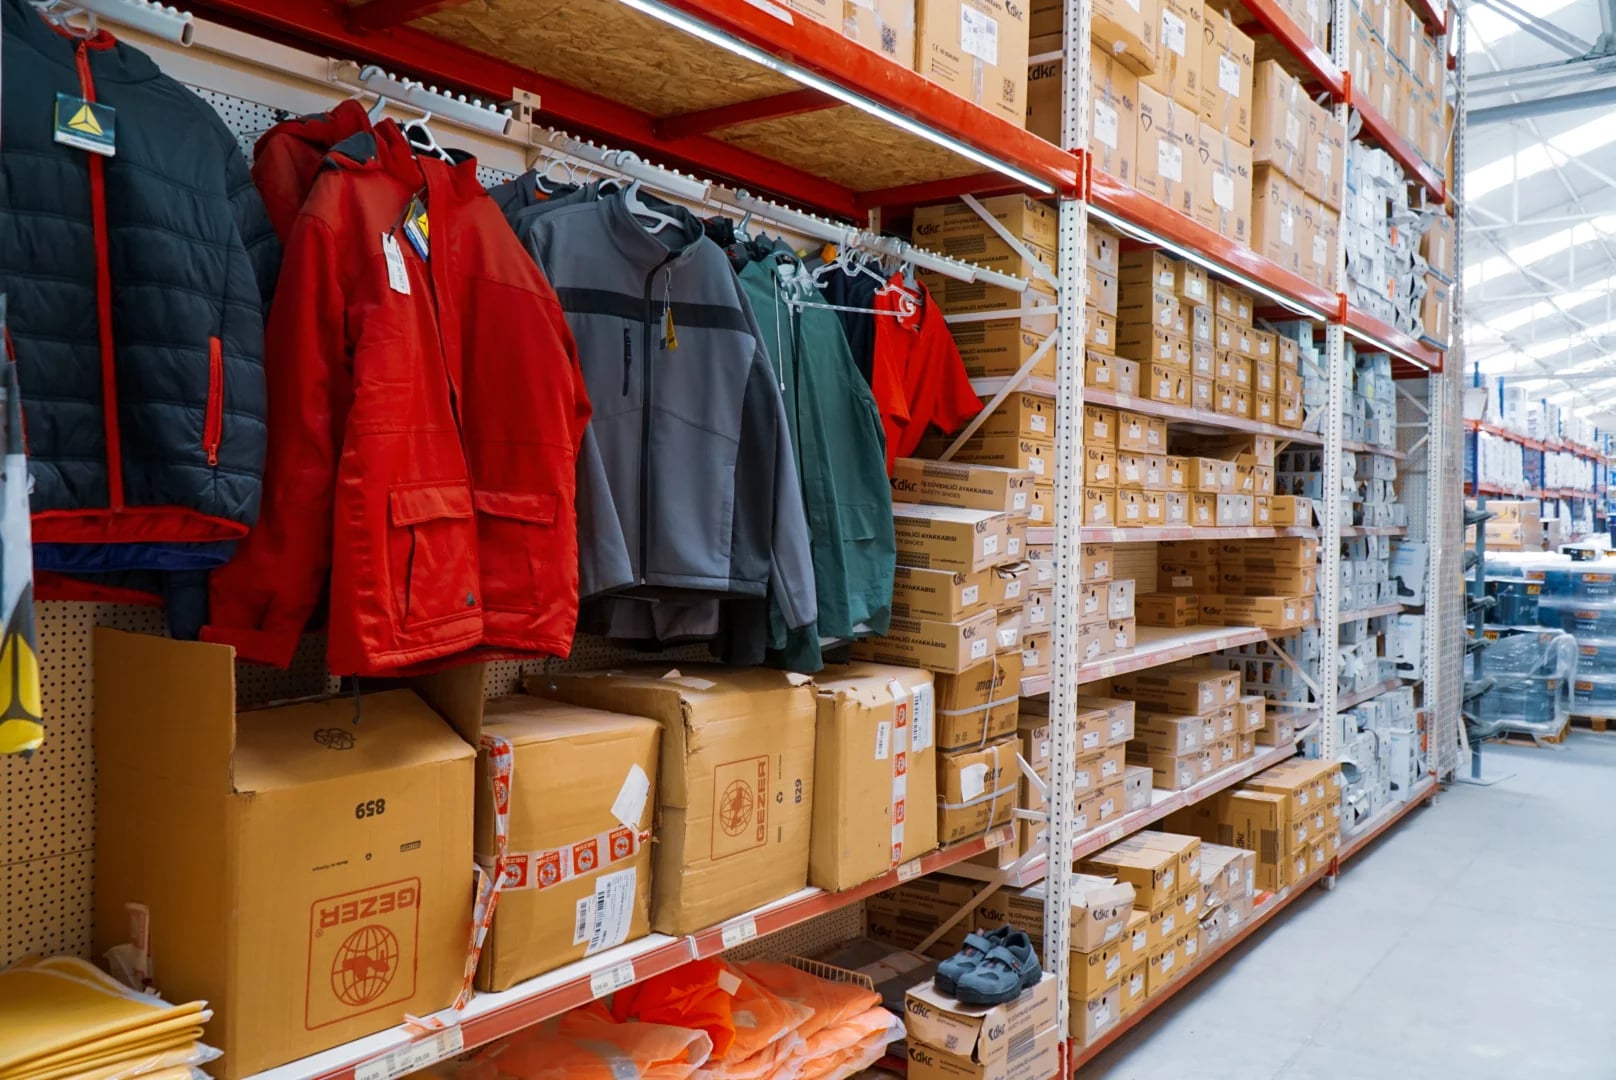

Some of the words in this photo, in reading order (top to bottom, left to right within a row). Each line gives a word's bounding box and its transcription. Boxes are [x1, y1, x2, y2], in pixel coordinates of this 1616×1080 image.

[354, 798, 386, 819] 859
[756, 760, 767, 842] GEZER
[319, 887, 416, 929] GEZER
